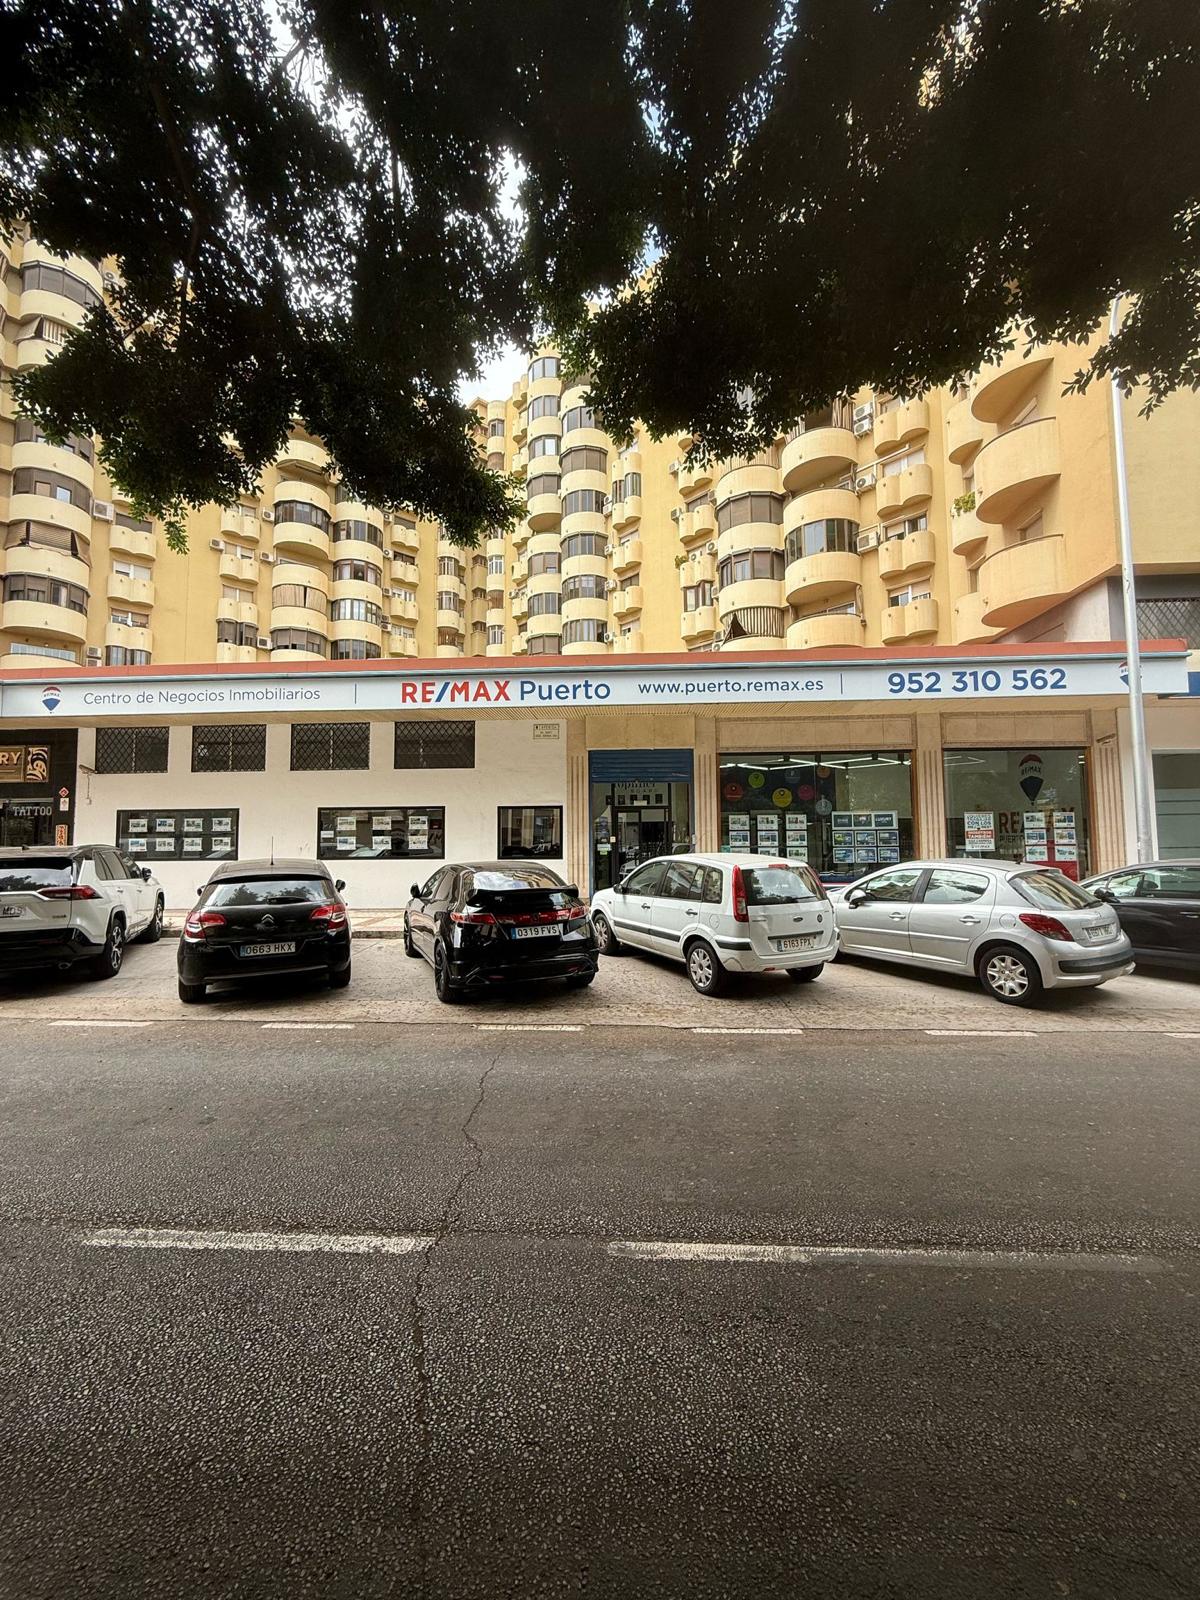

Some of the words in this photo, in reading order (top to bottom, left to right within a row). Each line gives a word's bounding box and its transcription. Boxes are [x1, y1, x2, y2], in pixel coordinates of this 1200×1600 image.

[638, 679, 824, 695] www.puerto.remax.es
[887, 671, 942, 694] 952
[951, 670, 1002, 692] 310
[1011, 668, 1067, 690] 562
[83, 691, 131, 705] Centro
[136, 691, 154, 703] de
[158, 689, 225, 705] Negocios
[229, 687, 320, 702] Inmobiliarios
[401, 680, 511, 703] RE/MAX
[520, 680, 611, 700] Puerto
[12, 806, 52, 816] TATTOO
[517, 927, 539, 937] 0319
[245, 945, 271, 955] 0663
[274, 943, 293, 952] HKX
[784, 940, 800, 949] 6163
